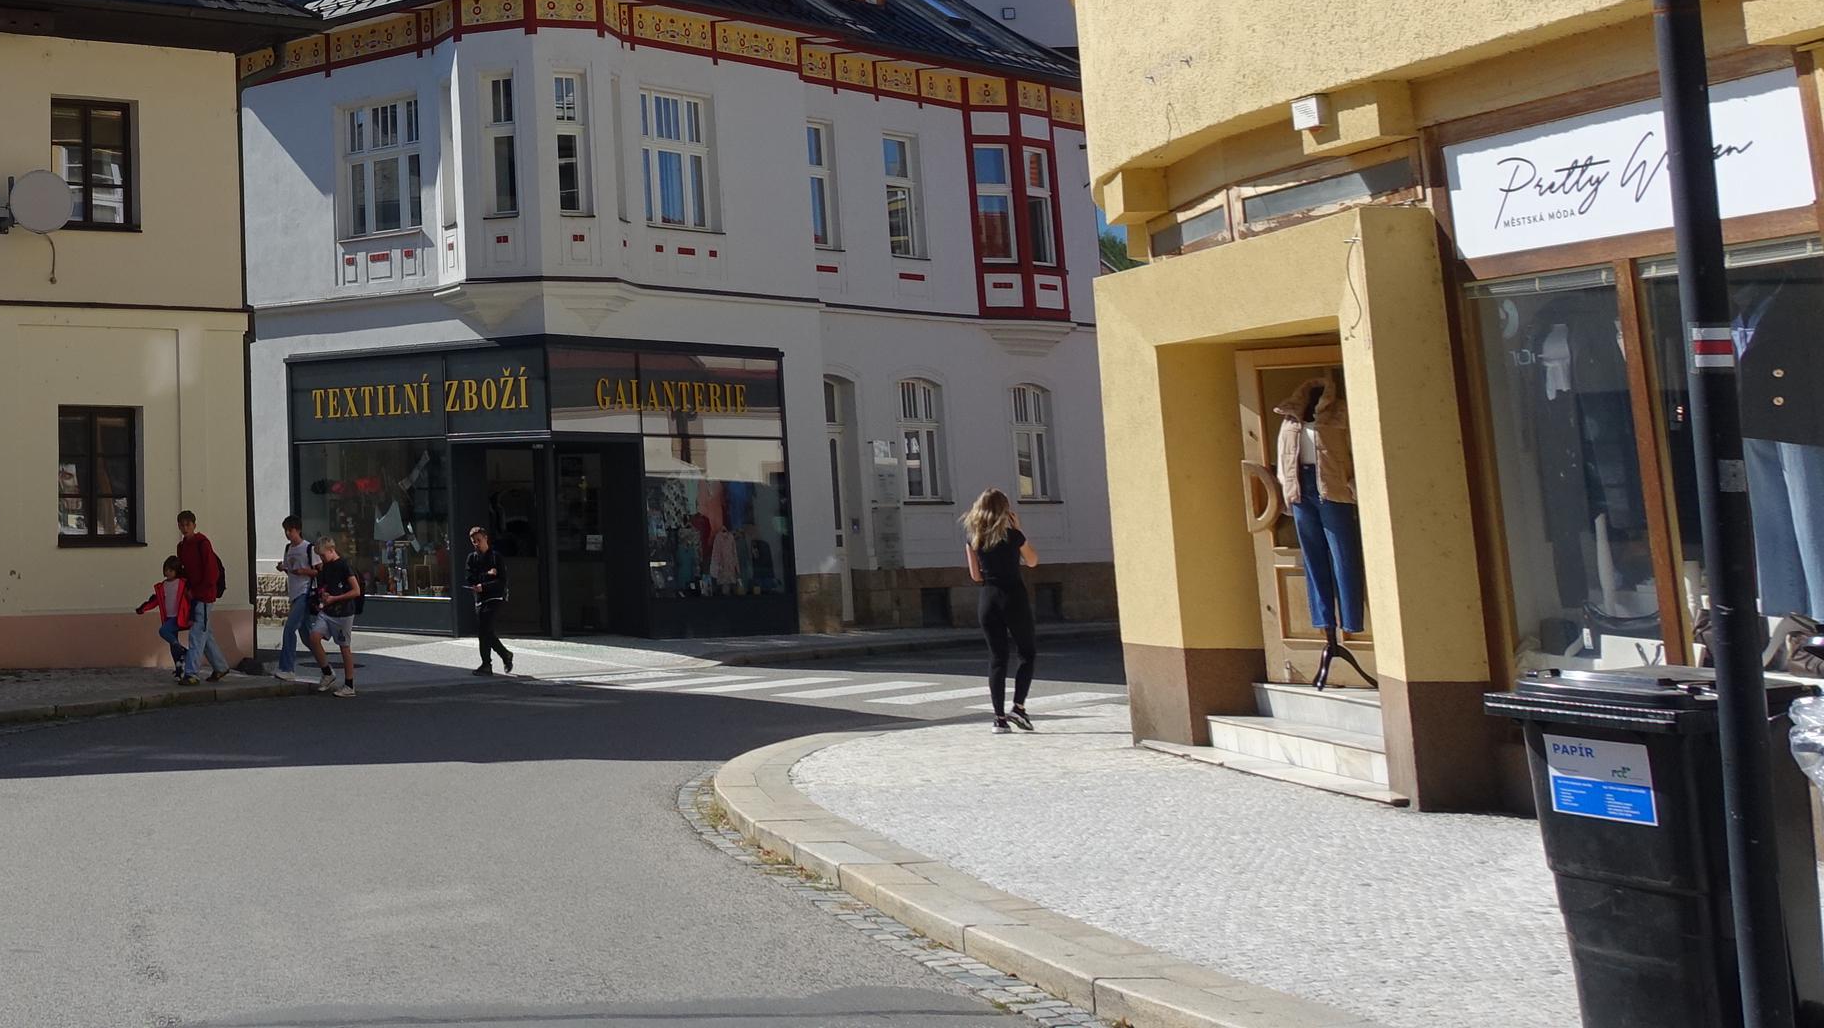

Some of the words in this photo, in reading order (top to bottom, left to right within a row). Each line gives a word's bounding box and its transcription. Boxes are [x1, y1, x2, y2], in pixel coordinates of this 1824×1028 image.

[1495, 155, 1610, 229] Pretty
[1503, 213, 1545, 228] MĚSTSKÁ
[1548, 209, 1576, 221] MÓDA
[312, 373, 431, 419] TEXTILNÍ
[445, 367, 529, 412] ZBOŽÍ
[596, 378, 748, 413] GALANTERIE
[1552, 743, 1595, 758] PAPÍR
